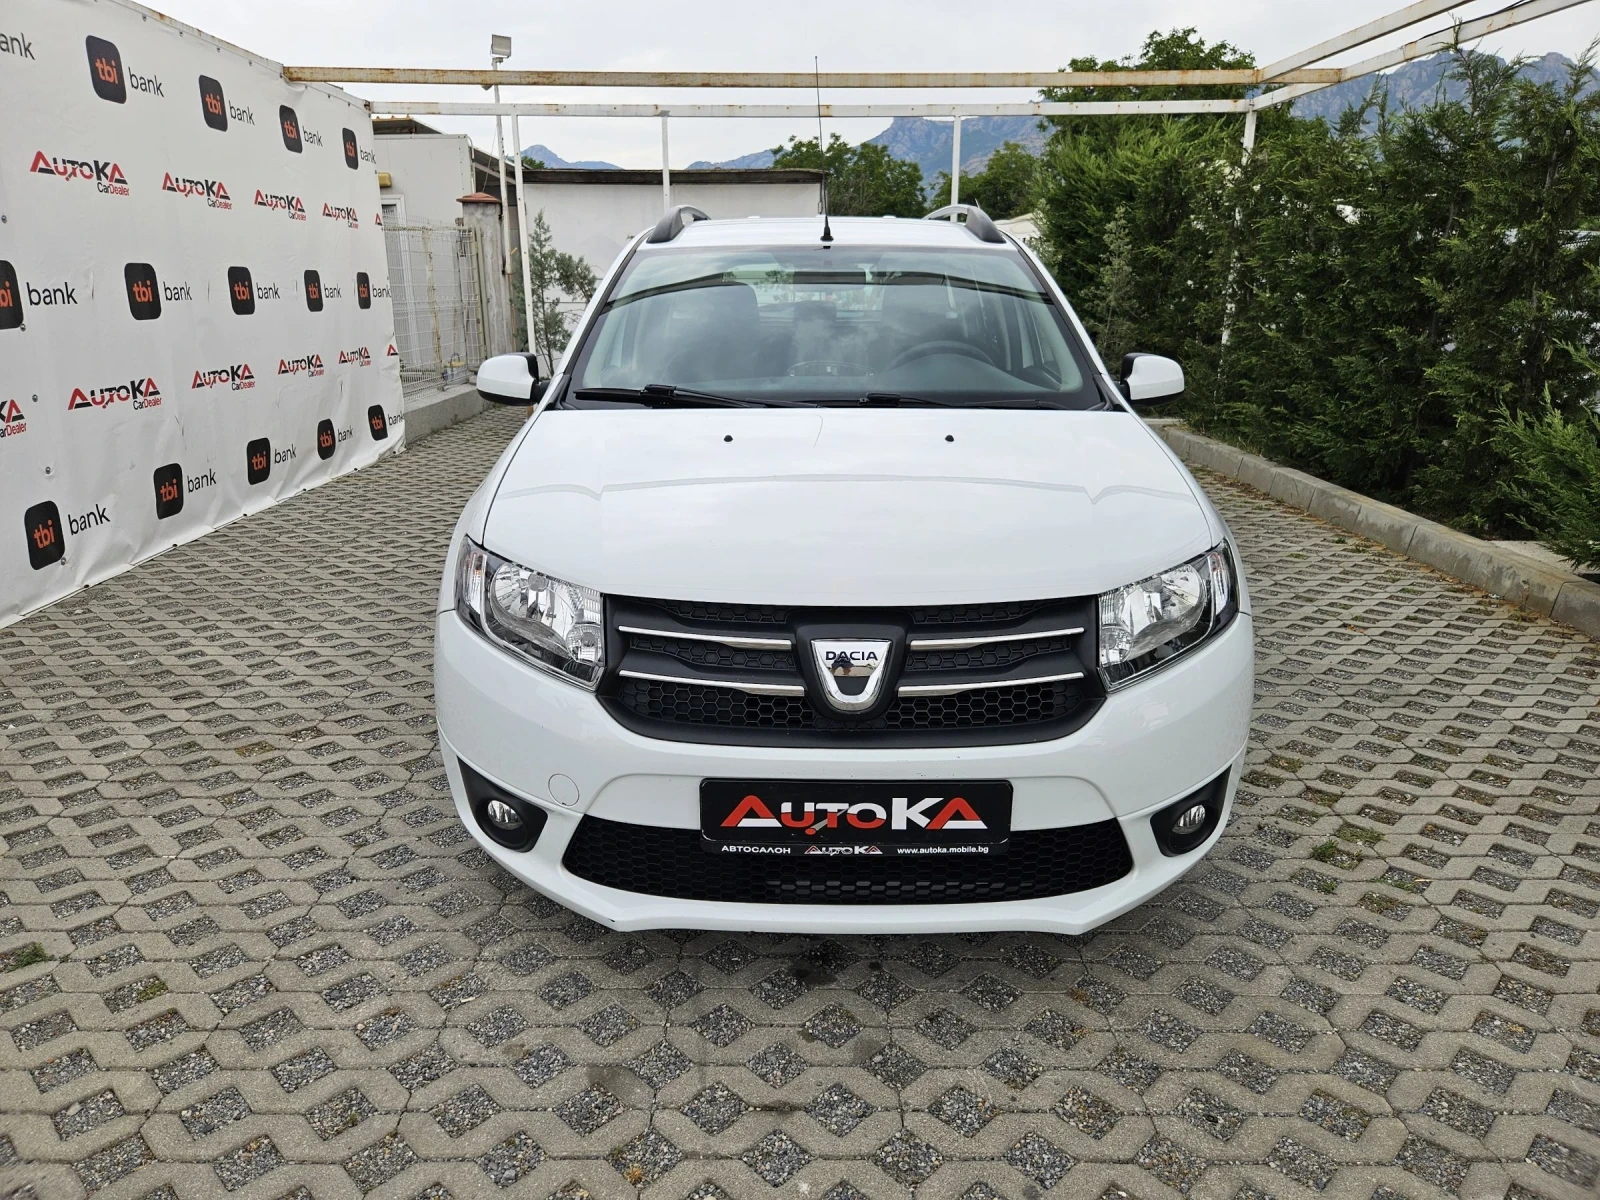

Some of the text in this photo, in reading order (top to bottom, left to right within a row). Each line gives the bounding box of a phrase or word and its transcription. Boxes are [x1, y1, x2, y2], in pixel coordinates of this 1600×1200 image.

[95, 58, 164, 97] tbi bank
[205, 94, 255, 125] tbi bank
[284, 121, 323, 147] tbi bank
[346, 142, 355, 158] tbi
[207, 198, 232, 210] CarDealer
[26, 282, 78, 306] bank
[133, 280, 192, 303] tbi bank
[234, 283, 280, 301] tbi bank
[308, 284, 341, 300] tbi bank
[359, 285, 368, 298] tbi
[371, 417, 383, 431] tbi
[320, 425, 353, 448] tbi bank
[252, 444, 296, 471] tbi bank
[160, 468, 216, 502] tbi bank
[34, 504, 110, 549] tbi bank
[825, 651, 879, 661] DACIA
[721, 845, 791, 855] АВТОСАЛОН
[897, 845, 989, 856] www.autoka.mobile.bg
